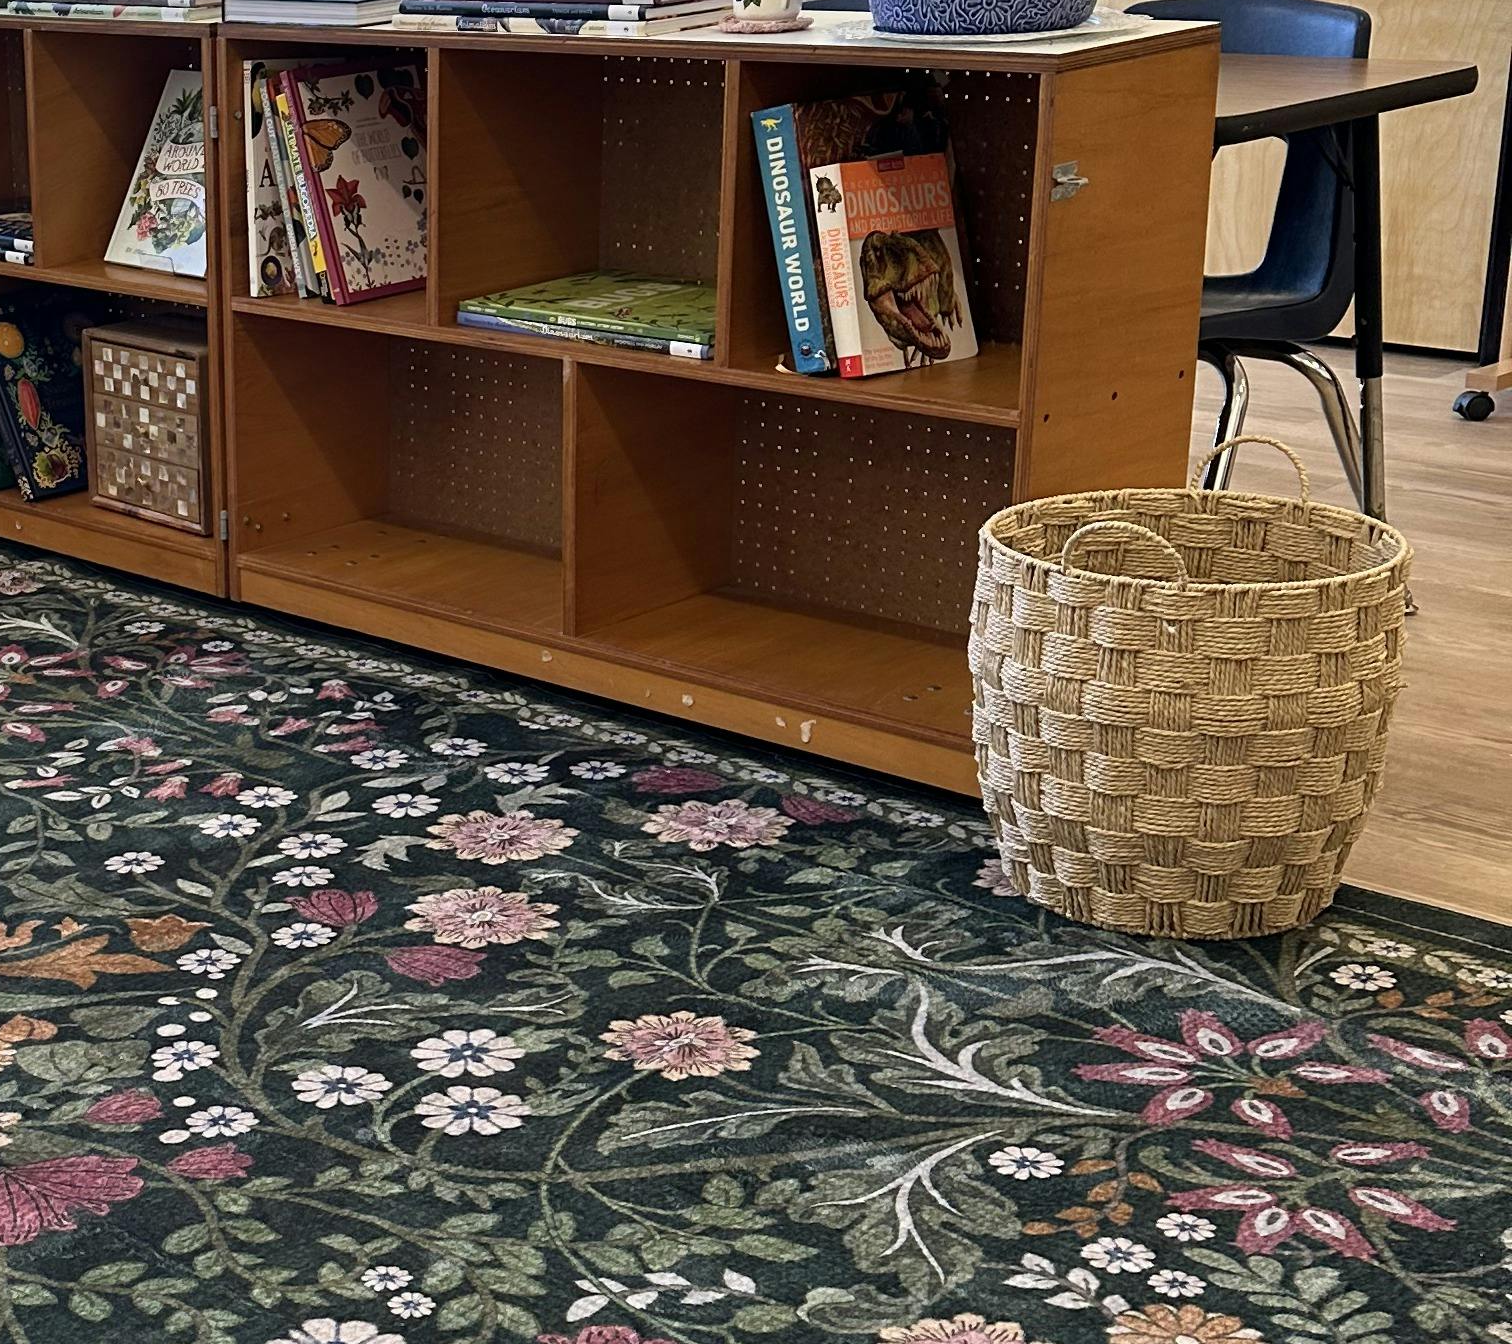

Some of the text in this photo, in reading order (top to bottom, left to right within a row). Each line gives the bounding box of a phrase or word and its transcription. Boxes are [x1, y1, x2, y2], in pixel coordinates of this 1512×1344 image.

[163, 158, 200, 172] WORLD
[173, 181, 202, 199] TREES
[845, 181, 950, 218] DINOSAURS
[296, 173, 317, 239] BUGOPEDIA
[849, 207, 953, 233] AND PREHISTORIC LIFE
[766, 136, 810, 333] DINOSAUR WORLD
[826, 228, 850, 309] DINOSAURS
[564, 283, 683, 309] BUGS
[557, 315, 577, 326] BUGS
